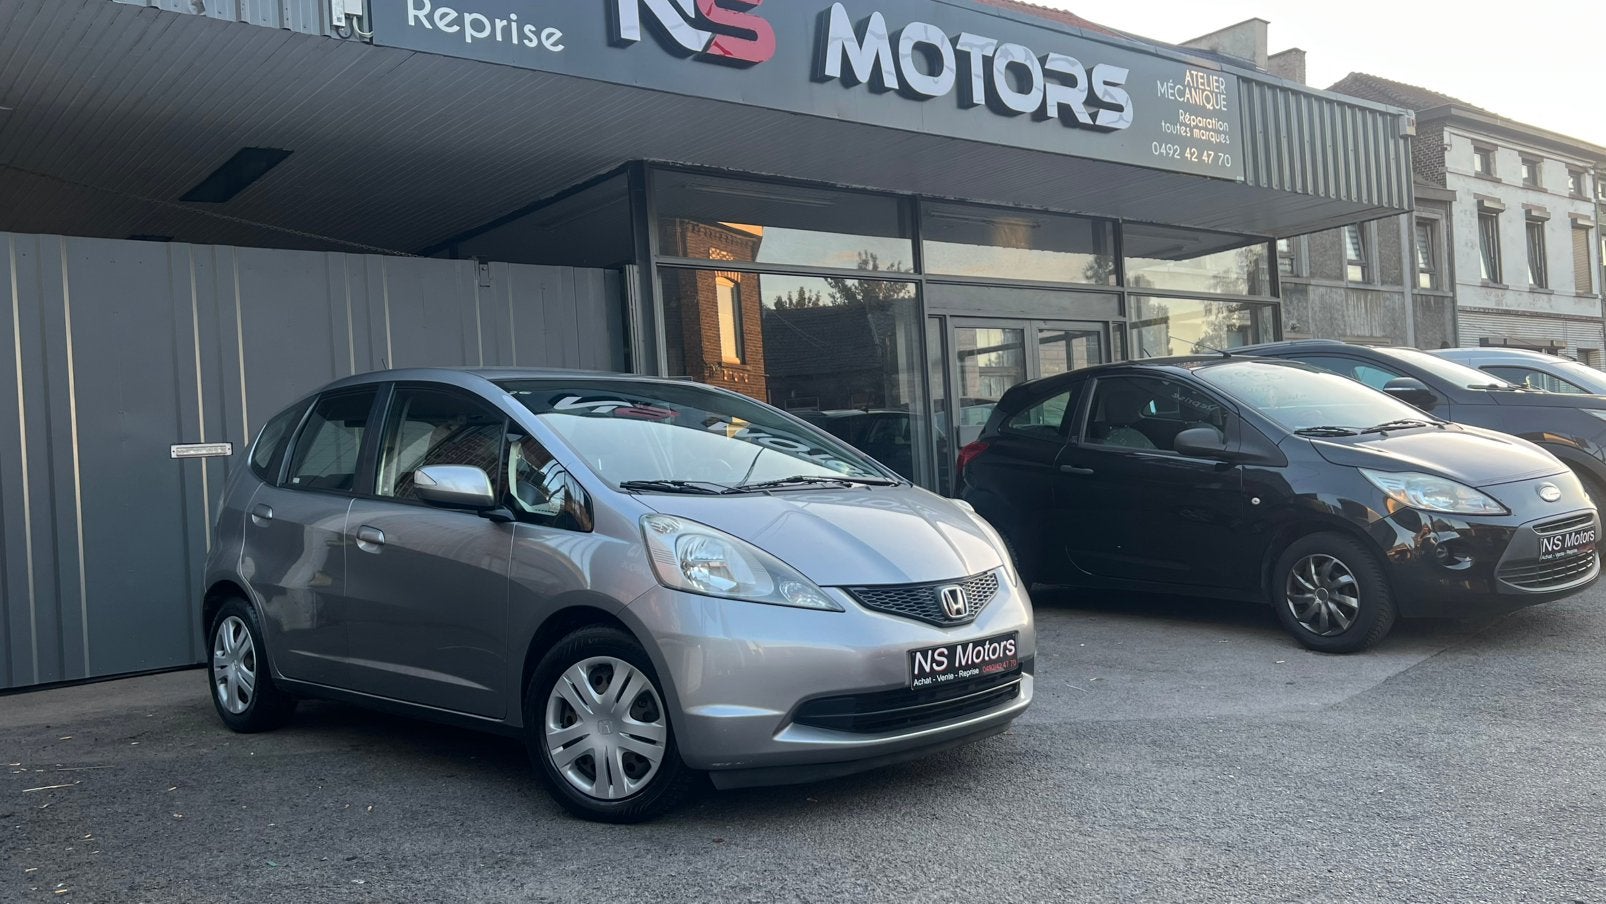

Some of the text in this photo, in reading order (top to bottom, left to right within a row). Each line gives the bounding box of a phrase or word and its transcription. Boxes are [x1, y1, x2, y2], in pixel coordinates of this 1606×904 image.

[407, 0, 566, 52] Reprise
[824, 2, 1134, 130] MOTORS
[1184, 69, 1227, 94] ATELIER
[1156, 80, 1228, 111] MÉCANIQUE
[1161, 120, 1230, 144] toutes marques
[1179, 109, 1229, 132] Réparation
[1151, 141, 1232, 167] 0492 42 47 70
[1542, 535, 1562, 553] NS
[1564, 530, 1595, 548] Motors
[914, 638, 1016, 675] NS Motors
[913, 676, 932, 687] Achat
[936, 672, 954, 683] Vente
[958, 667, 980, 679] Reprise
